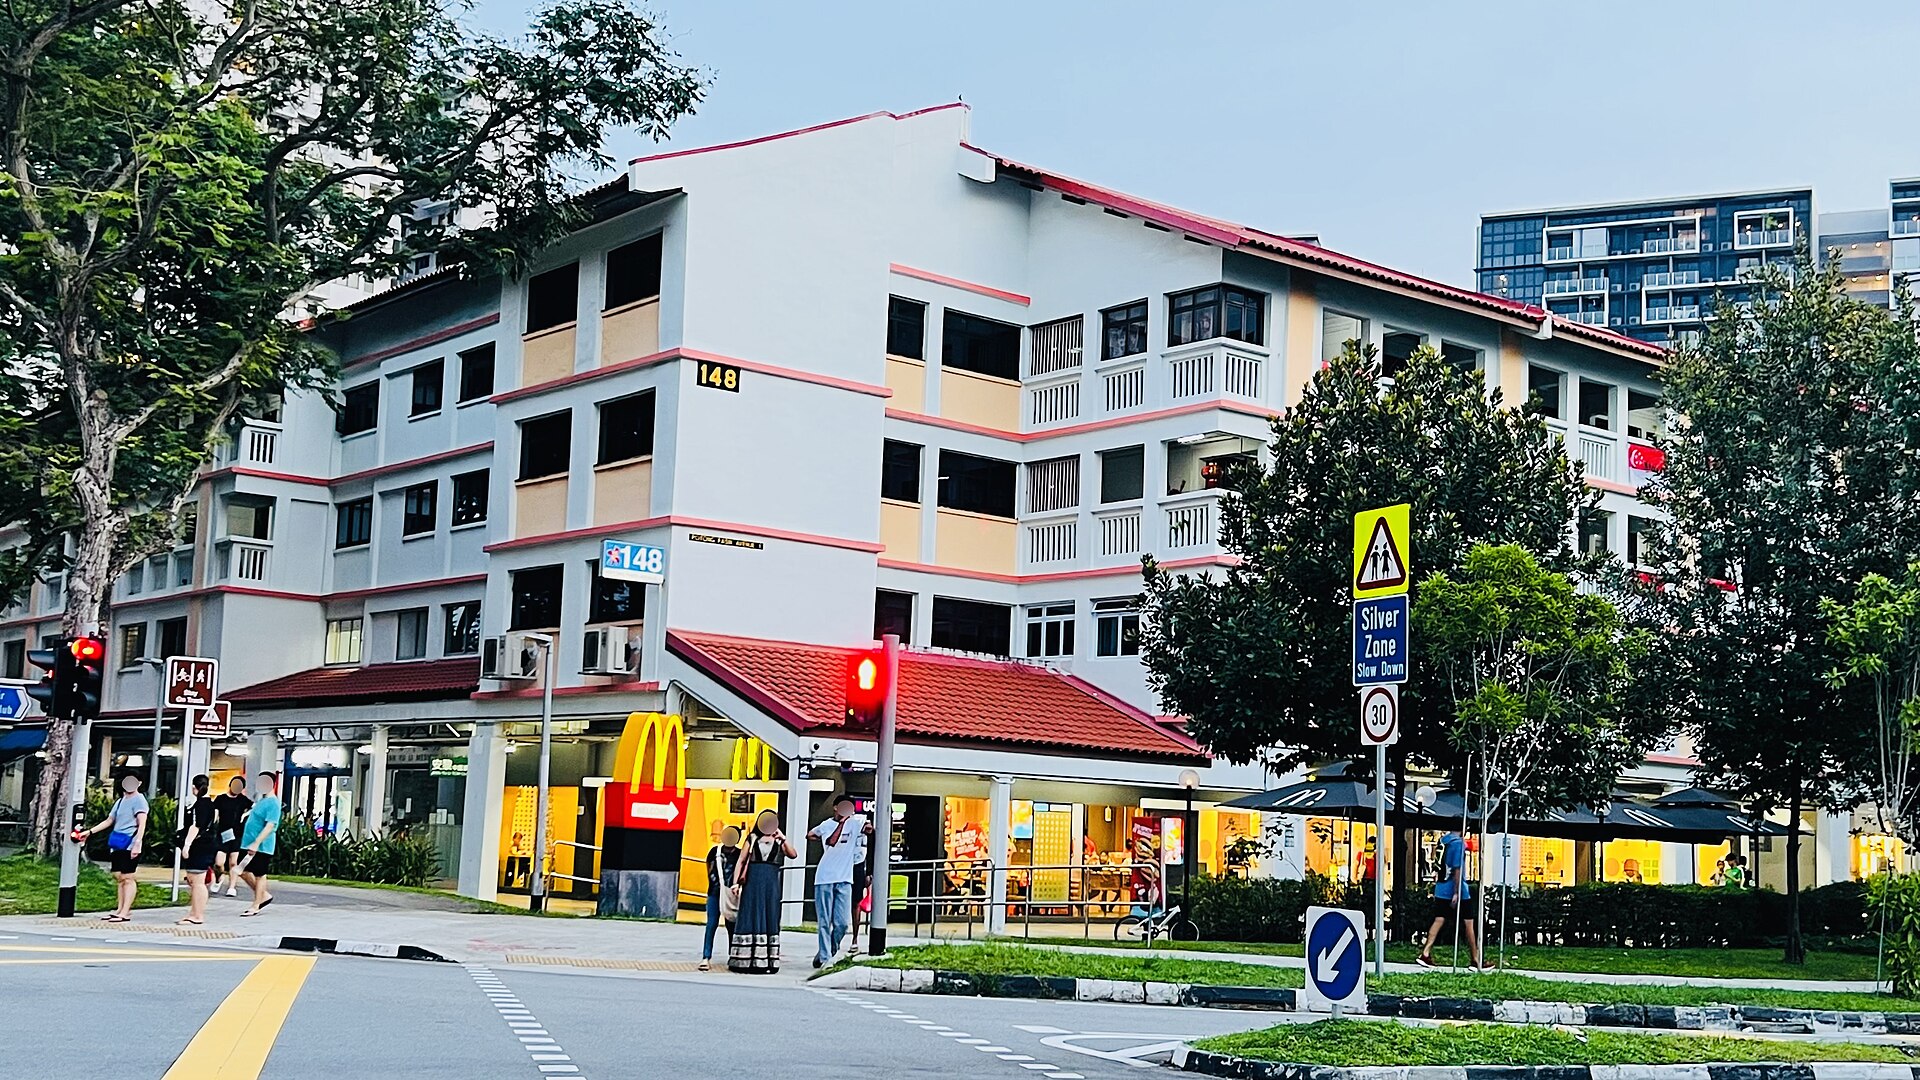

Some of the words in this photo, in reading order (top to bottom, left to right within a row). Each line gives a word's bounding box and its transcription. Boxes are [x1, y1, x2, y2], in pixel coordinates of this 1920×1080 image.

[700, 364, 737, 389] 148
[622, 545, 663, 574] 148
[1361, 605, 1400, 631] Silver
[1365, 634, 1396, 659] Zone
[1357, 662, 1377, 678] Slow
[1381, 661, 1404, 676] Down
[1372, 704, 1387, 726] 30
